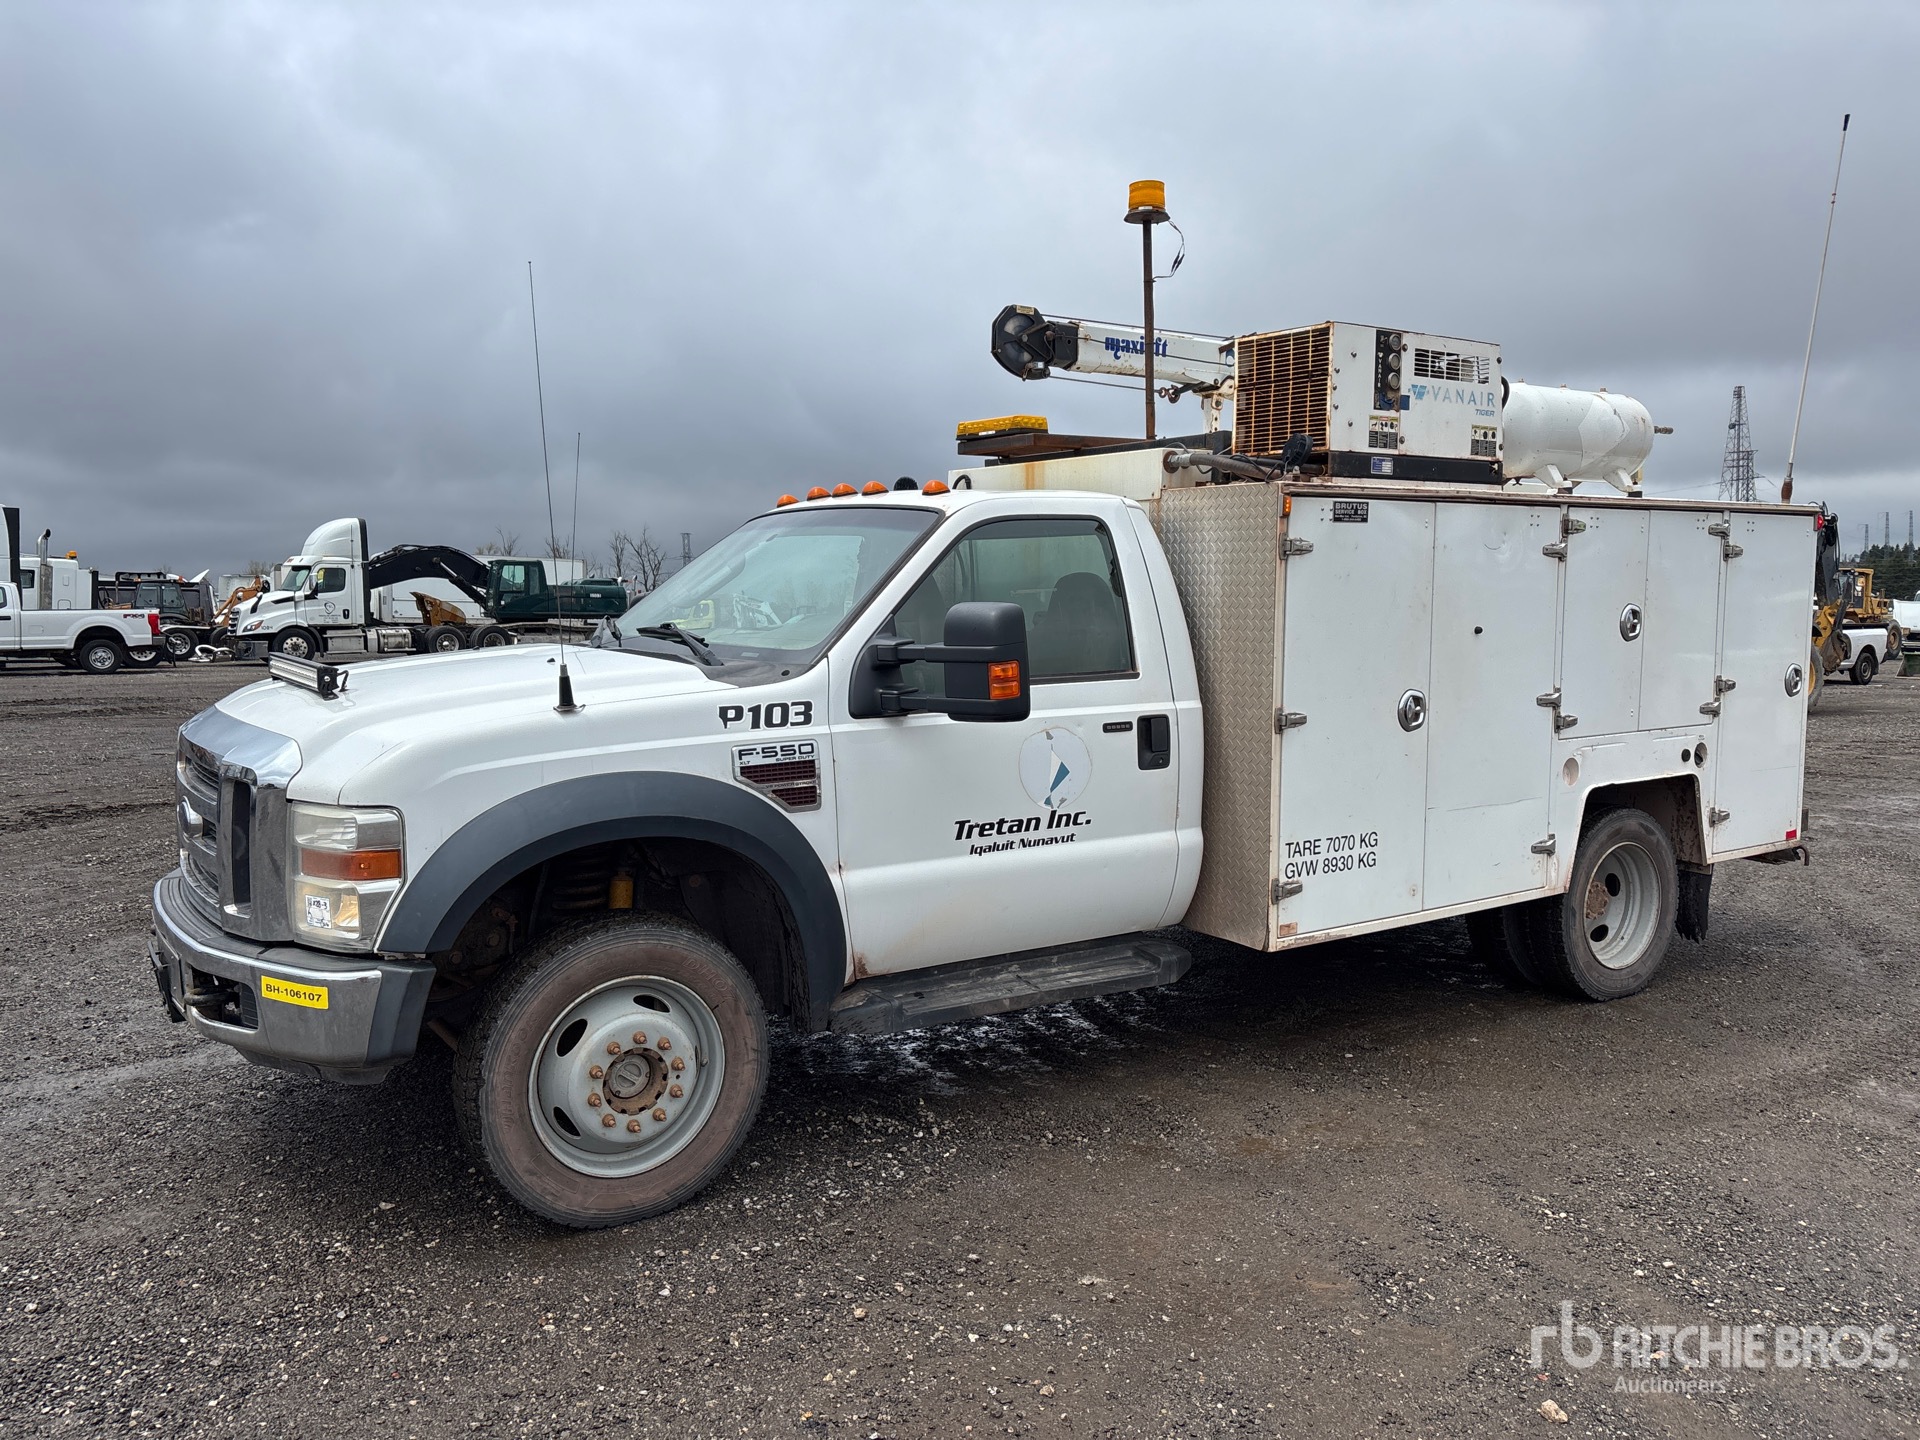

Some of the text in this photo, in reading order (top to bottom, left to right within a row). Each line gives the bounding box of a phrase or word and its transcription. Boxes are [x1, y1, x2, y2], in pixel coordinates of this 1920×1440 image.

[1105, 335, 1168, 360] maxift
[1431, 385, 1495, 407] VANAIR
[1475, 409, 1495, 417] TIGER
[1335, 502, 1368, 510] BRUTUS
[718, 700, 814, 730] P103
[738, 742, 815, 761] F-550
[954, 809, 1092, 841] Tretan Inc.
[969, 832, 1076, 857] Iqaluit Nunavut
[1285, 831, 1379, 859] TARE 7070 KG
[1284, 851, 1377, 880] GVW 8930 KG
[265, 983, 323, 1003] BH-106107
